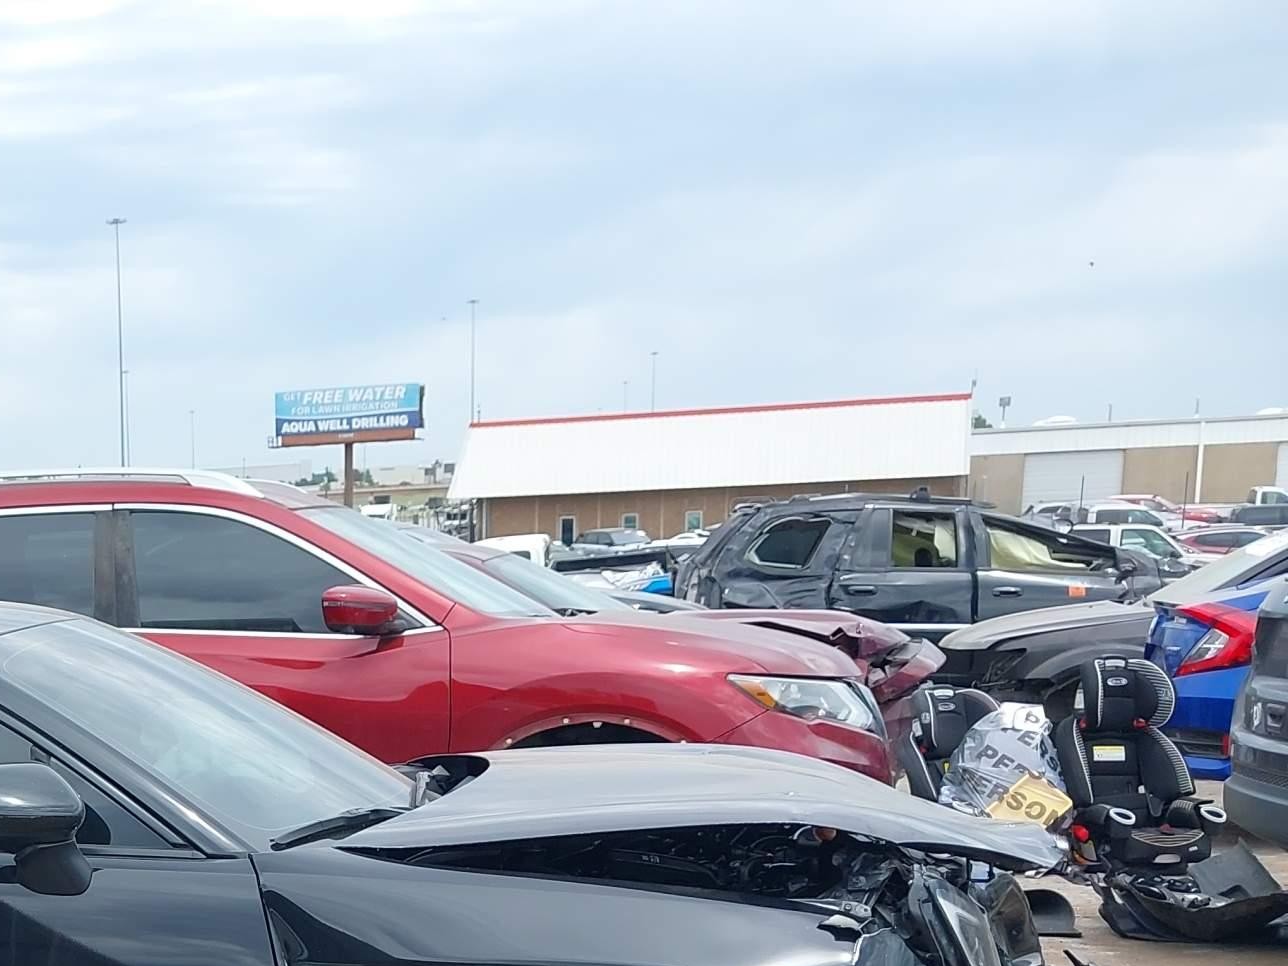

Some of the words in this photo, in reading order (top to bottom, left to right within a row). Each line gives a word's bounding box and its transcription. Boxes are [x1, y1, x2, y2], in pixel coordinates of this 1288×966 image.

[302, 388, 344, 405] FREE
[347, 385, 407, 402] WATER
[291, 407, 312, 416] FOR
[281, 422, 317, 433] AQUA
[318, 418, 350, 431] WELL
[351, 415, 409, 429] DRILLING
